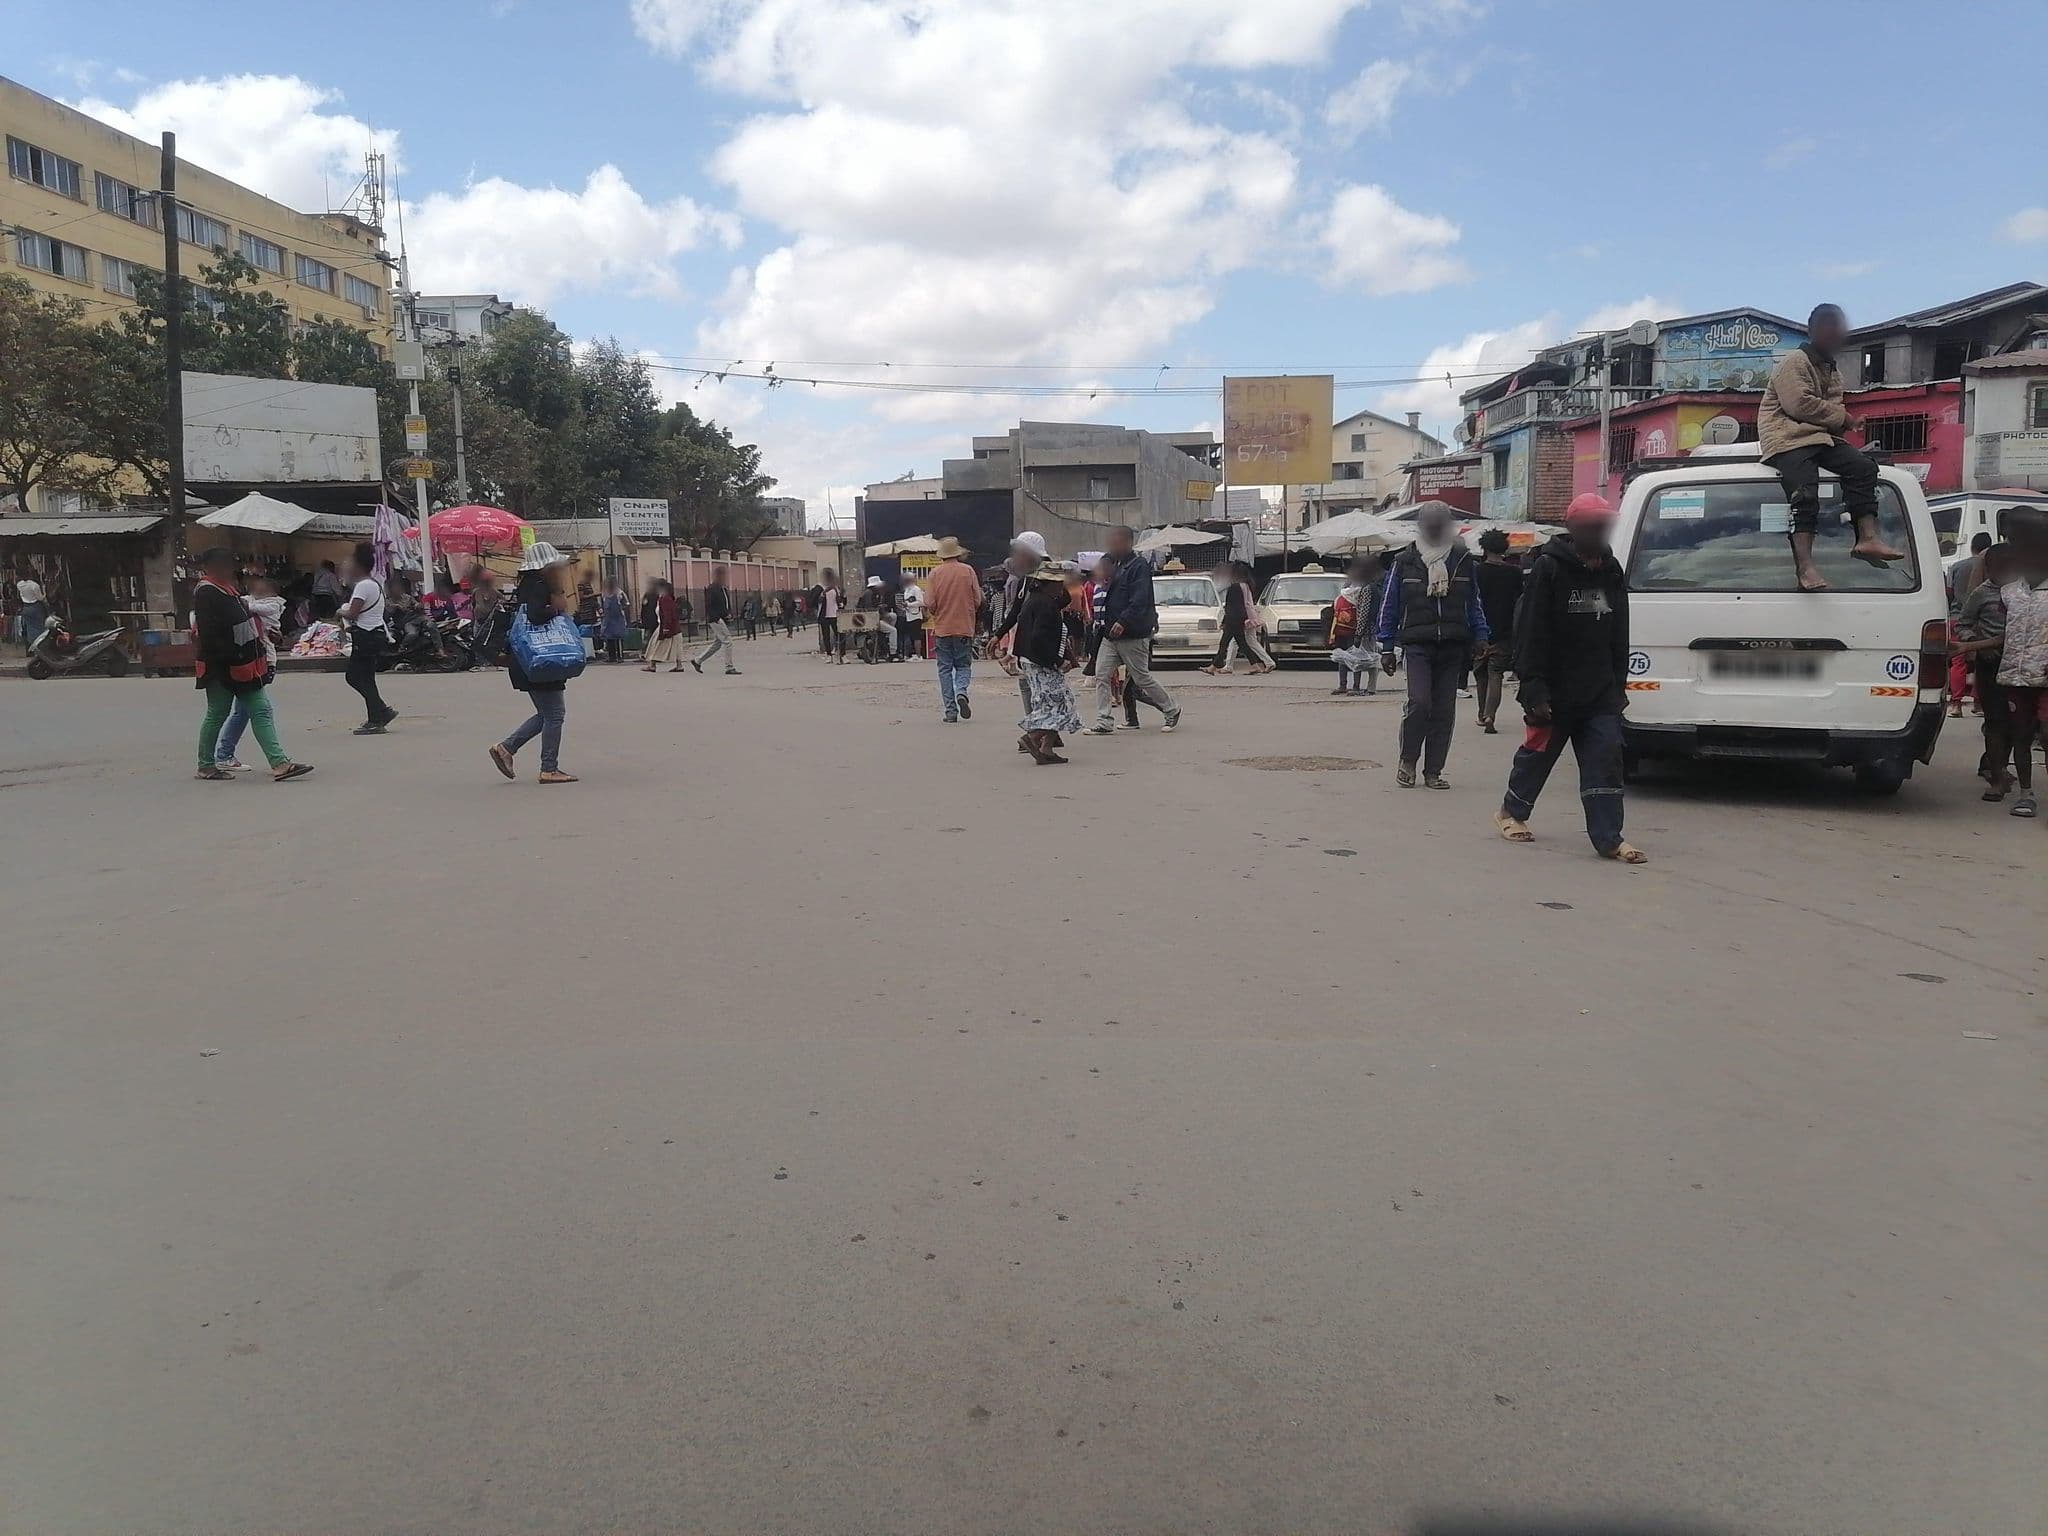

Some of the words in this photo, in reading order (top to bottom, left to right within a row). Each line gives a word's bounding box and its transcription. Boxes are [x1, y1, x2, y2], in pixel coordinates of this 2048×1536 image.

[1747, 324, 1778, 348] Coco
[1646, 438, 1667, 456] THB
[1420, 466, 1459, 474] PHOTOCOPIE
[1420, 480, 1465, 488] PLASTIFICATIO
[1739, 641, 1794, 649] TOYOTA
[1630, 658, 1646, 669] 75
[1891, 662, 1909, 674] KH
